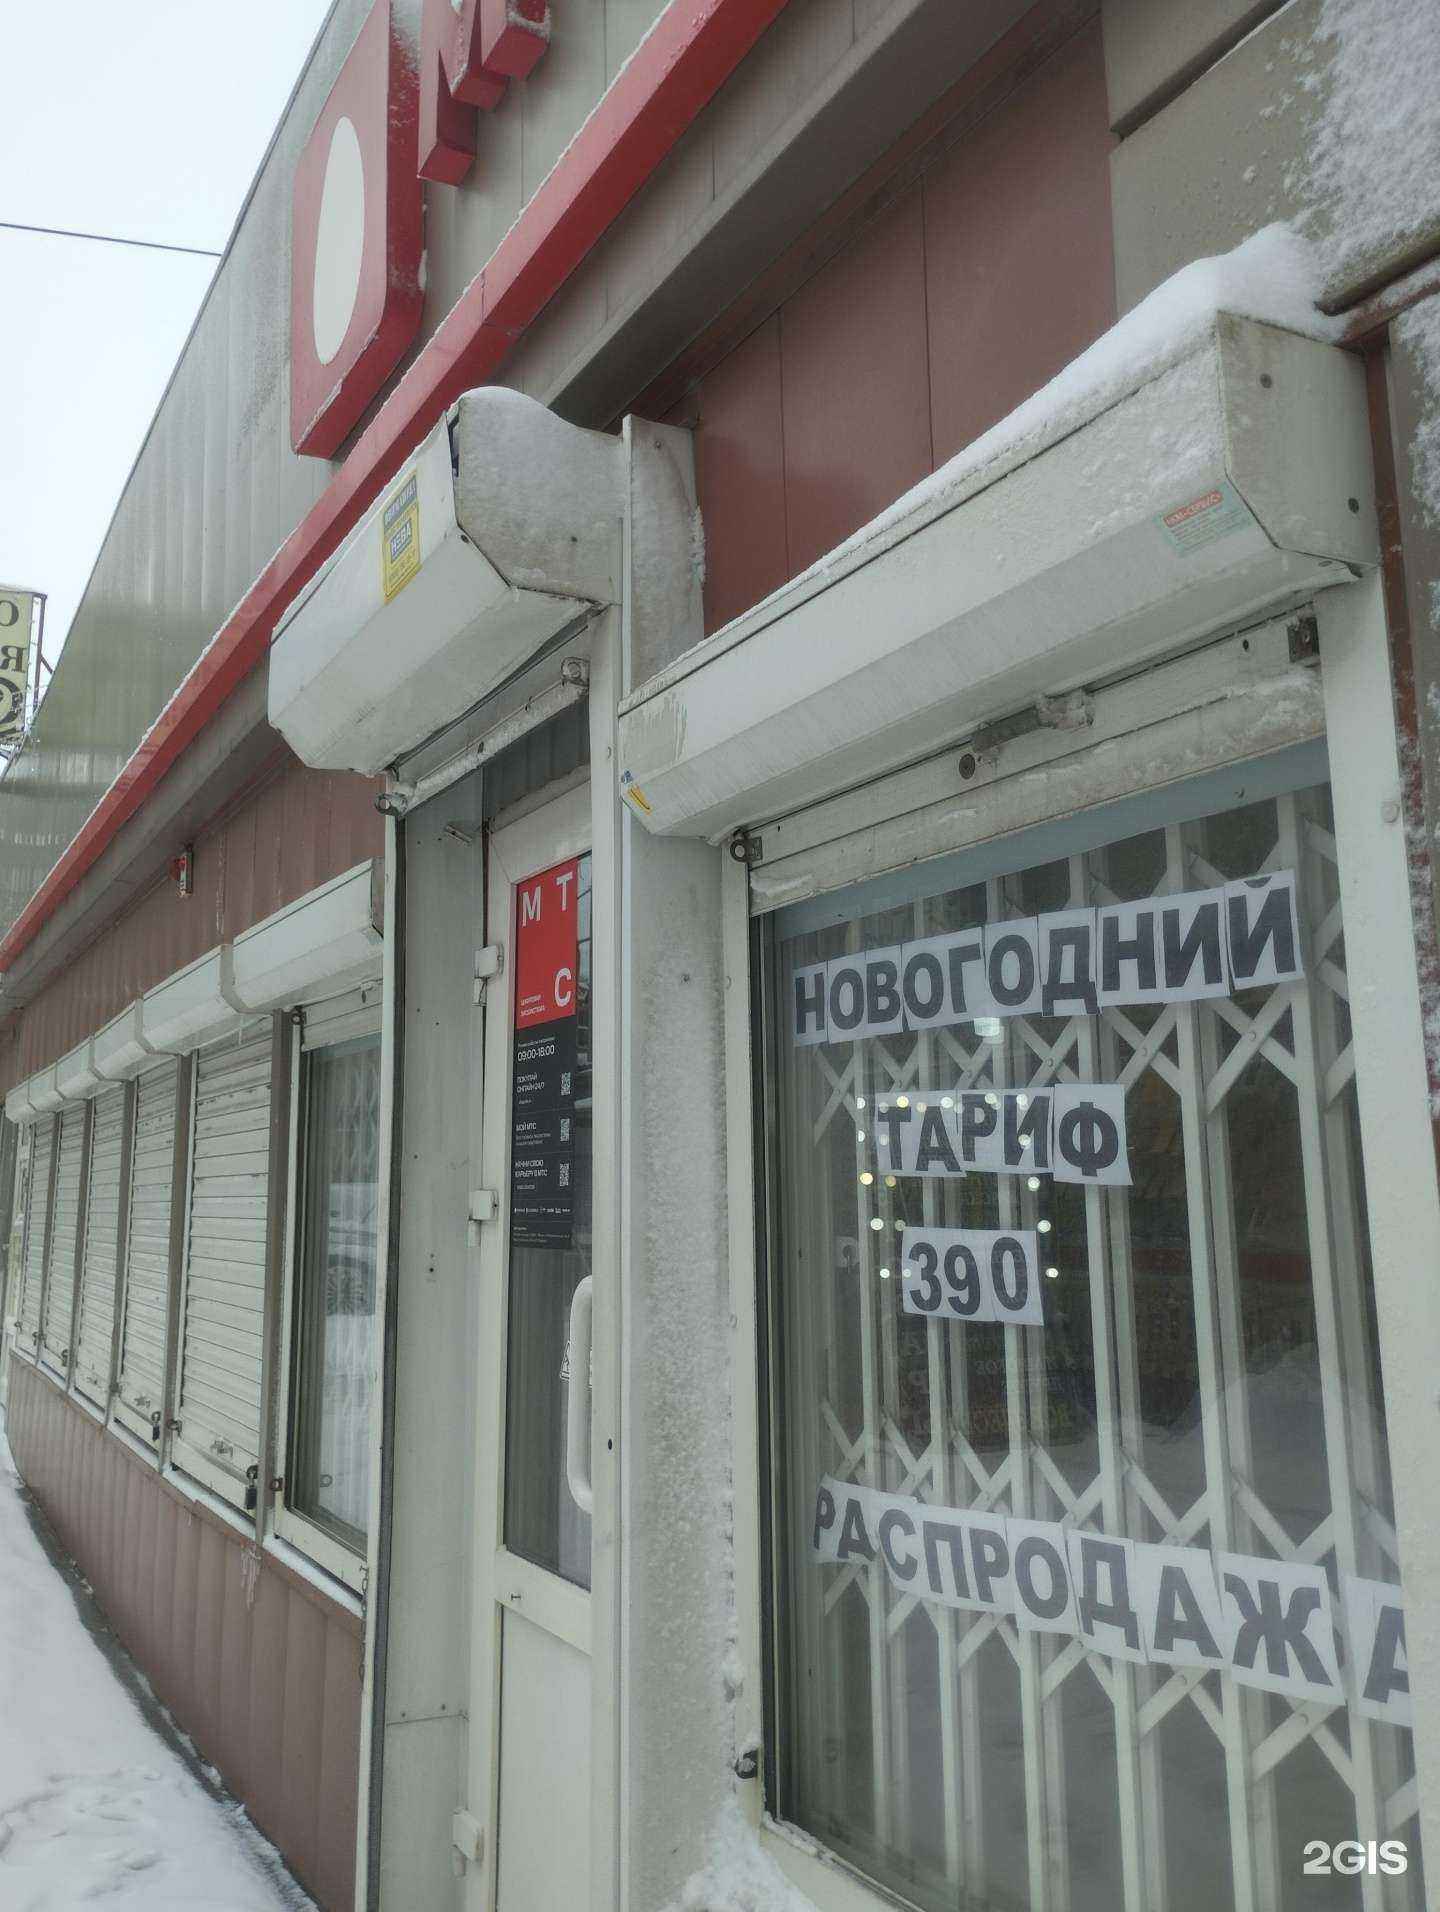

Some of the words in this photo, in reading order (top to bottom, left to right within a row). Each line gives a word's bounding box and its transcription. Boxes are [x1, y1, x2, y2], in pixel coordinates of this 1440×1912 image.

[795, 877, 1296, 1034] НОВОГОДНИЙ
[876, 1094, 1120, 1176] ТАРИФ
[907, 1236, 1029, 1315] 390
[814, 1486, 1410, 1704] РАСПРОДАЖА
